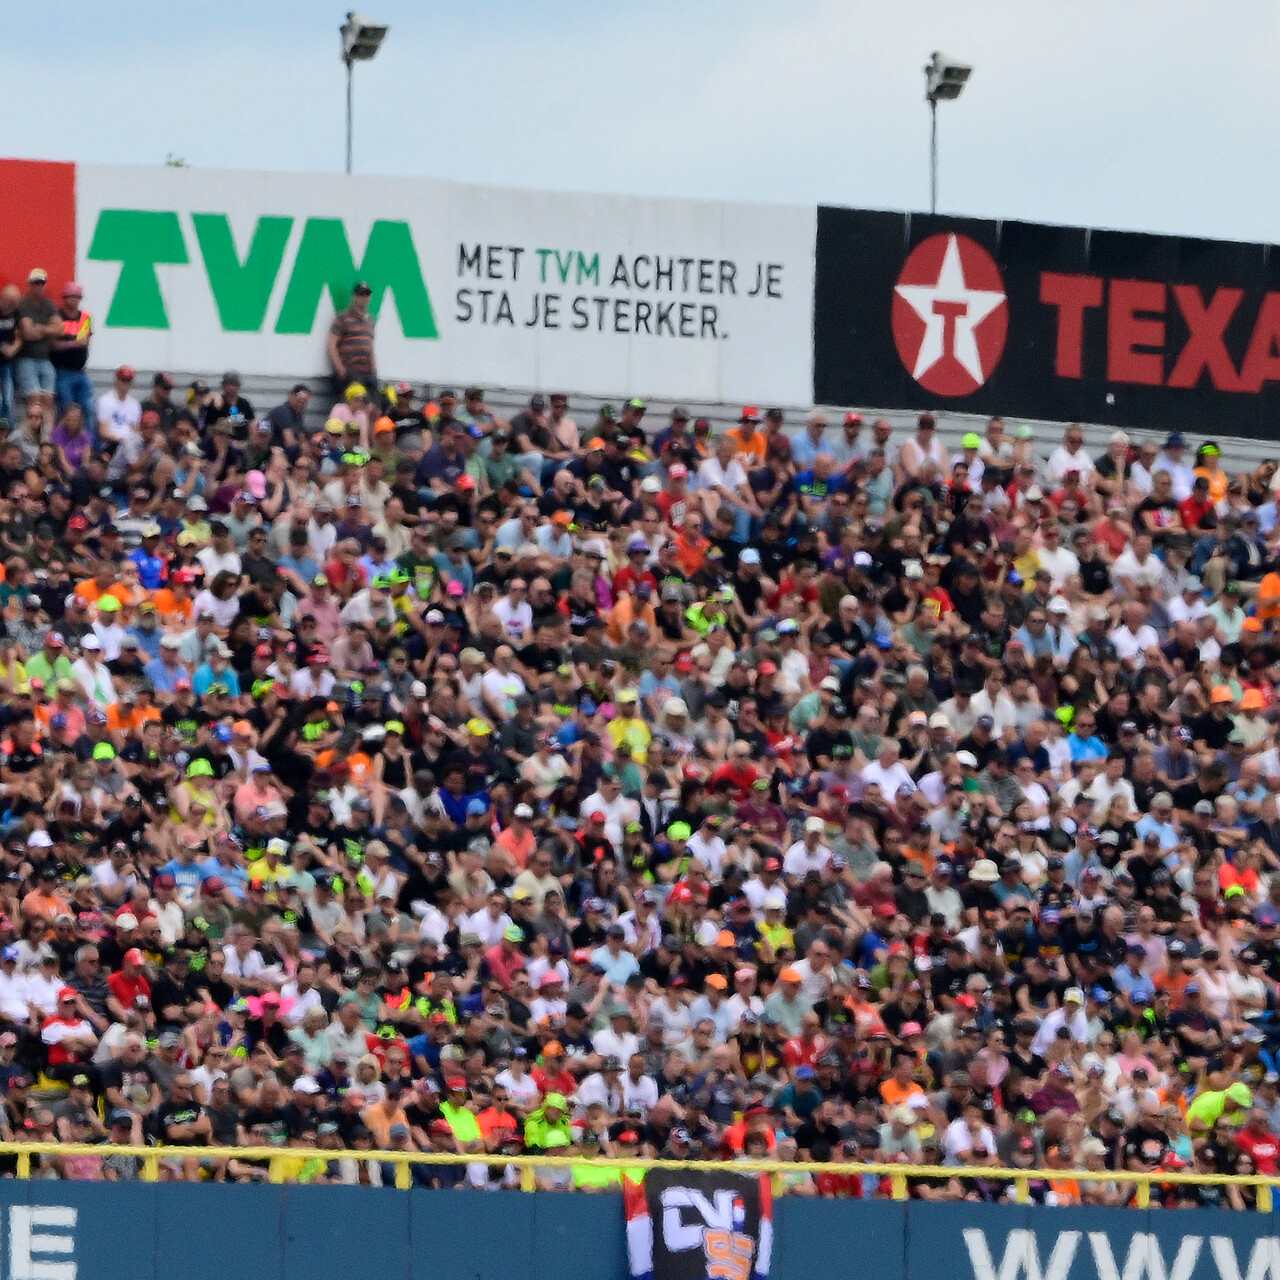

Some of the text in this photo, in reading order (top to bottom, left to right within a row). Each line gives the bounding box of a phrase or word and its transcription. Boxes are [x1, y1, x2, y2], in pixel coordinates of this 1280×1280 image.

[86, 209, 439, 341] TVM
[456, 242, 784, 298] MET TVM ACHTER JE
[455, 288, 730, 340] STA JE STERKER.
